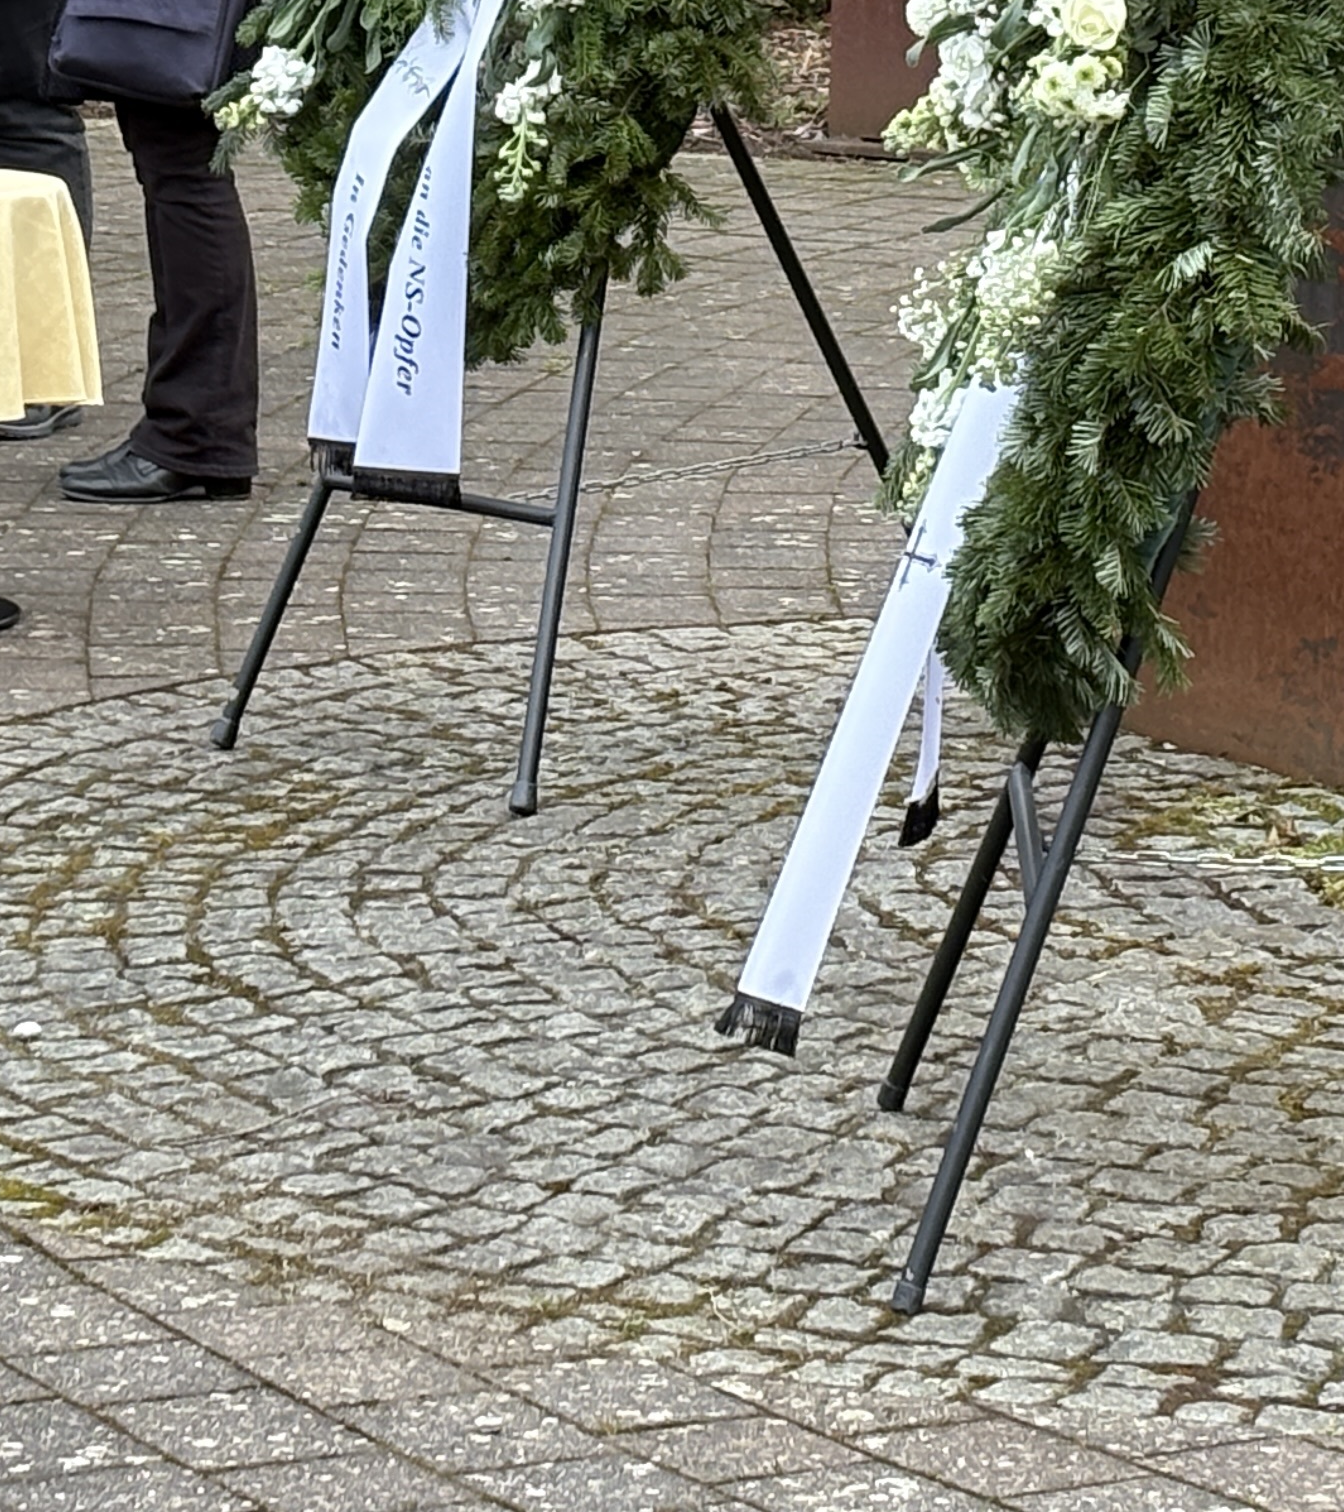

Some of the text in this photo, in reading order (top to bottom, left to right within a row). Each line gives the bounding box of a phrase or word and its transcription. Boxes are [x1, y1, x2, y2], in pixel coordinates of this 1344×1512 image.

[331, 212, 356, 350] Gedenken
[393, 166, 432, 396] an die NS-Opfer
